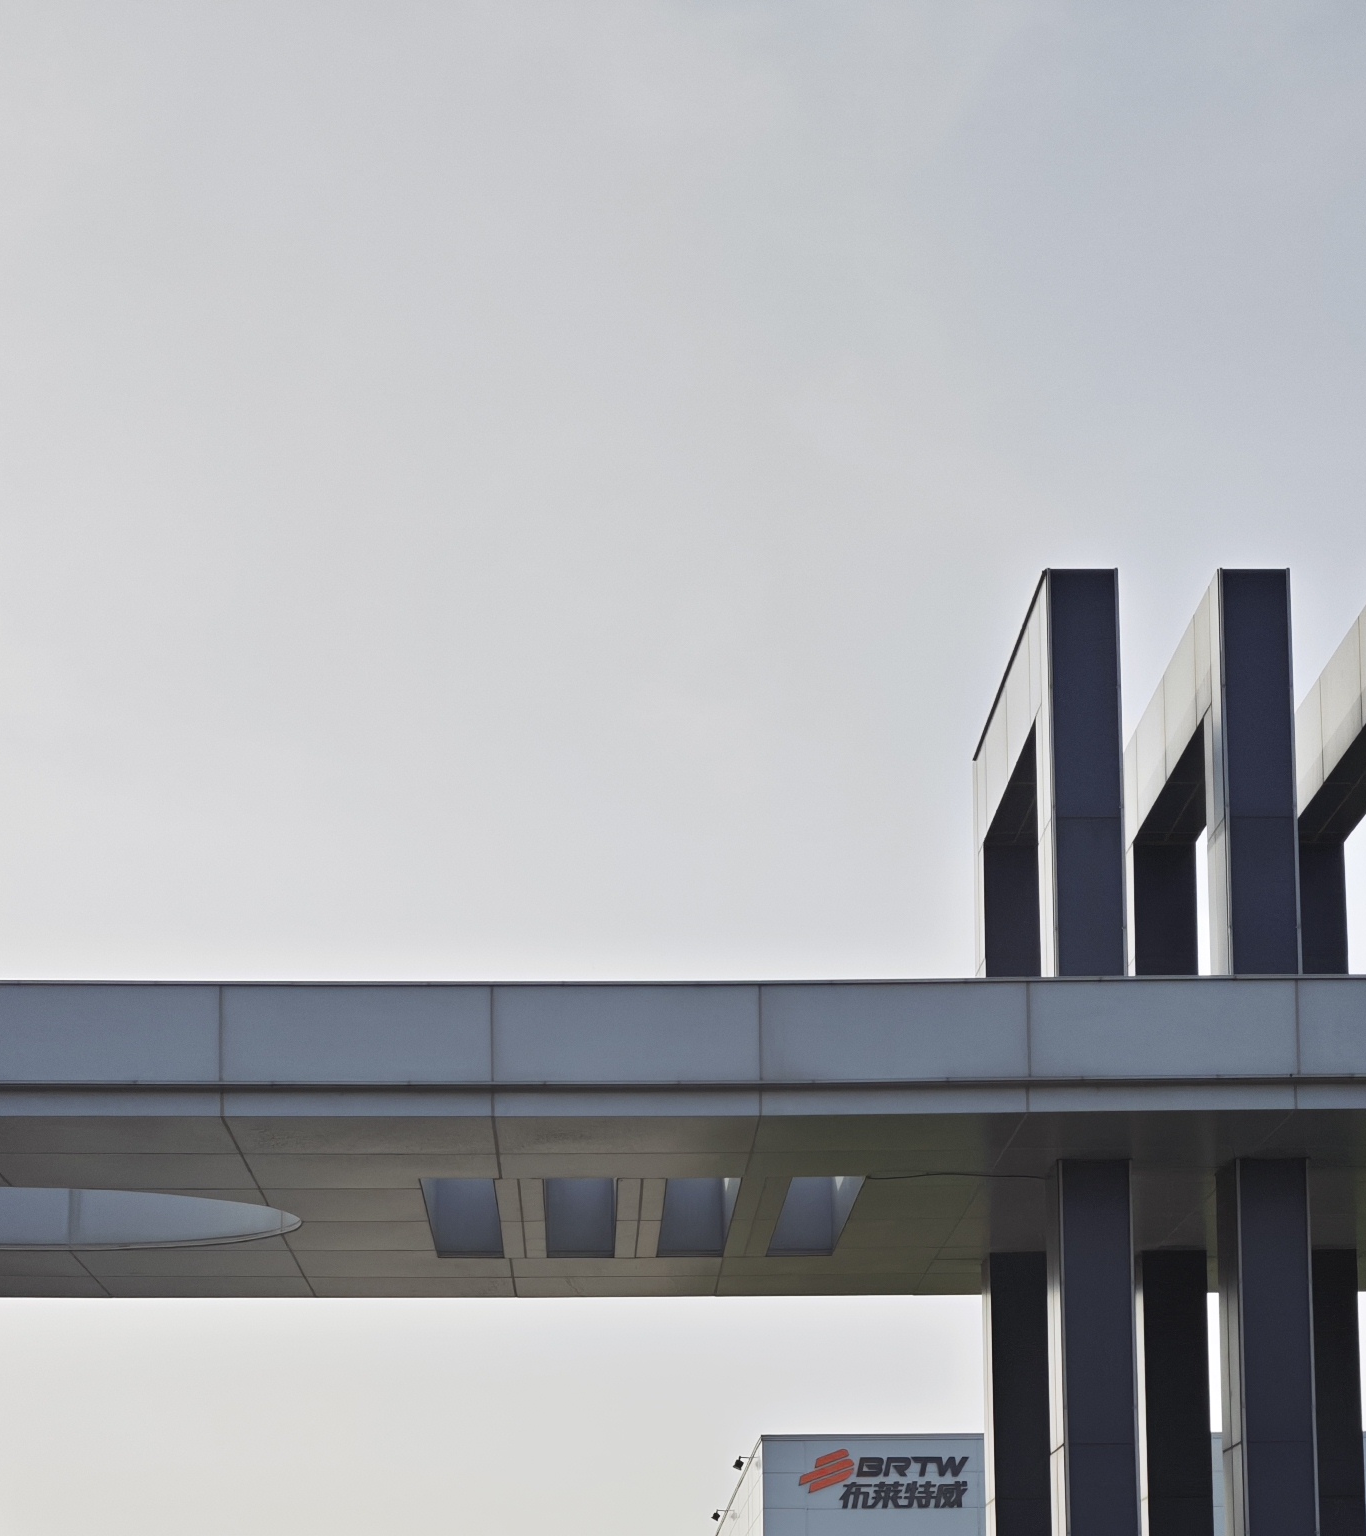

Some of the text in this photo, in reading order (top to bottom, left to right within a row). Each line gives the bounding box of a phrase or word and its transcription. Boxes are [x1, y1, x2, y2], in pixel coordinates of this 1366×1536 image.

[856, 1456, 969, 1477] BRTW
[839, 1481, 968, 1509] 布莱特威
